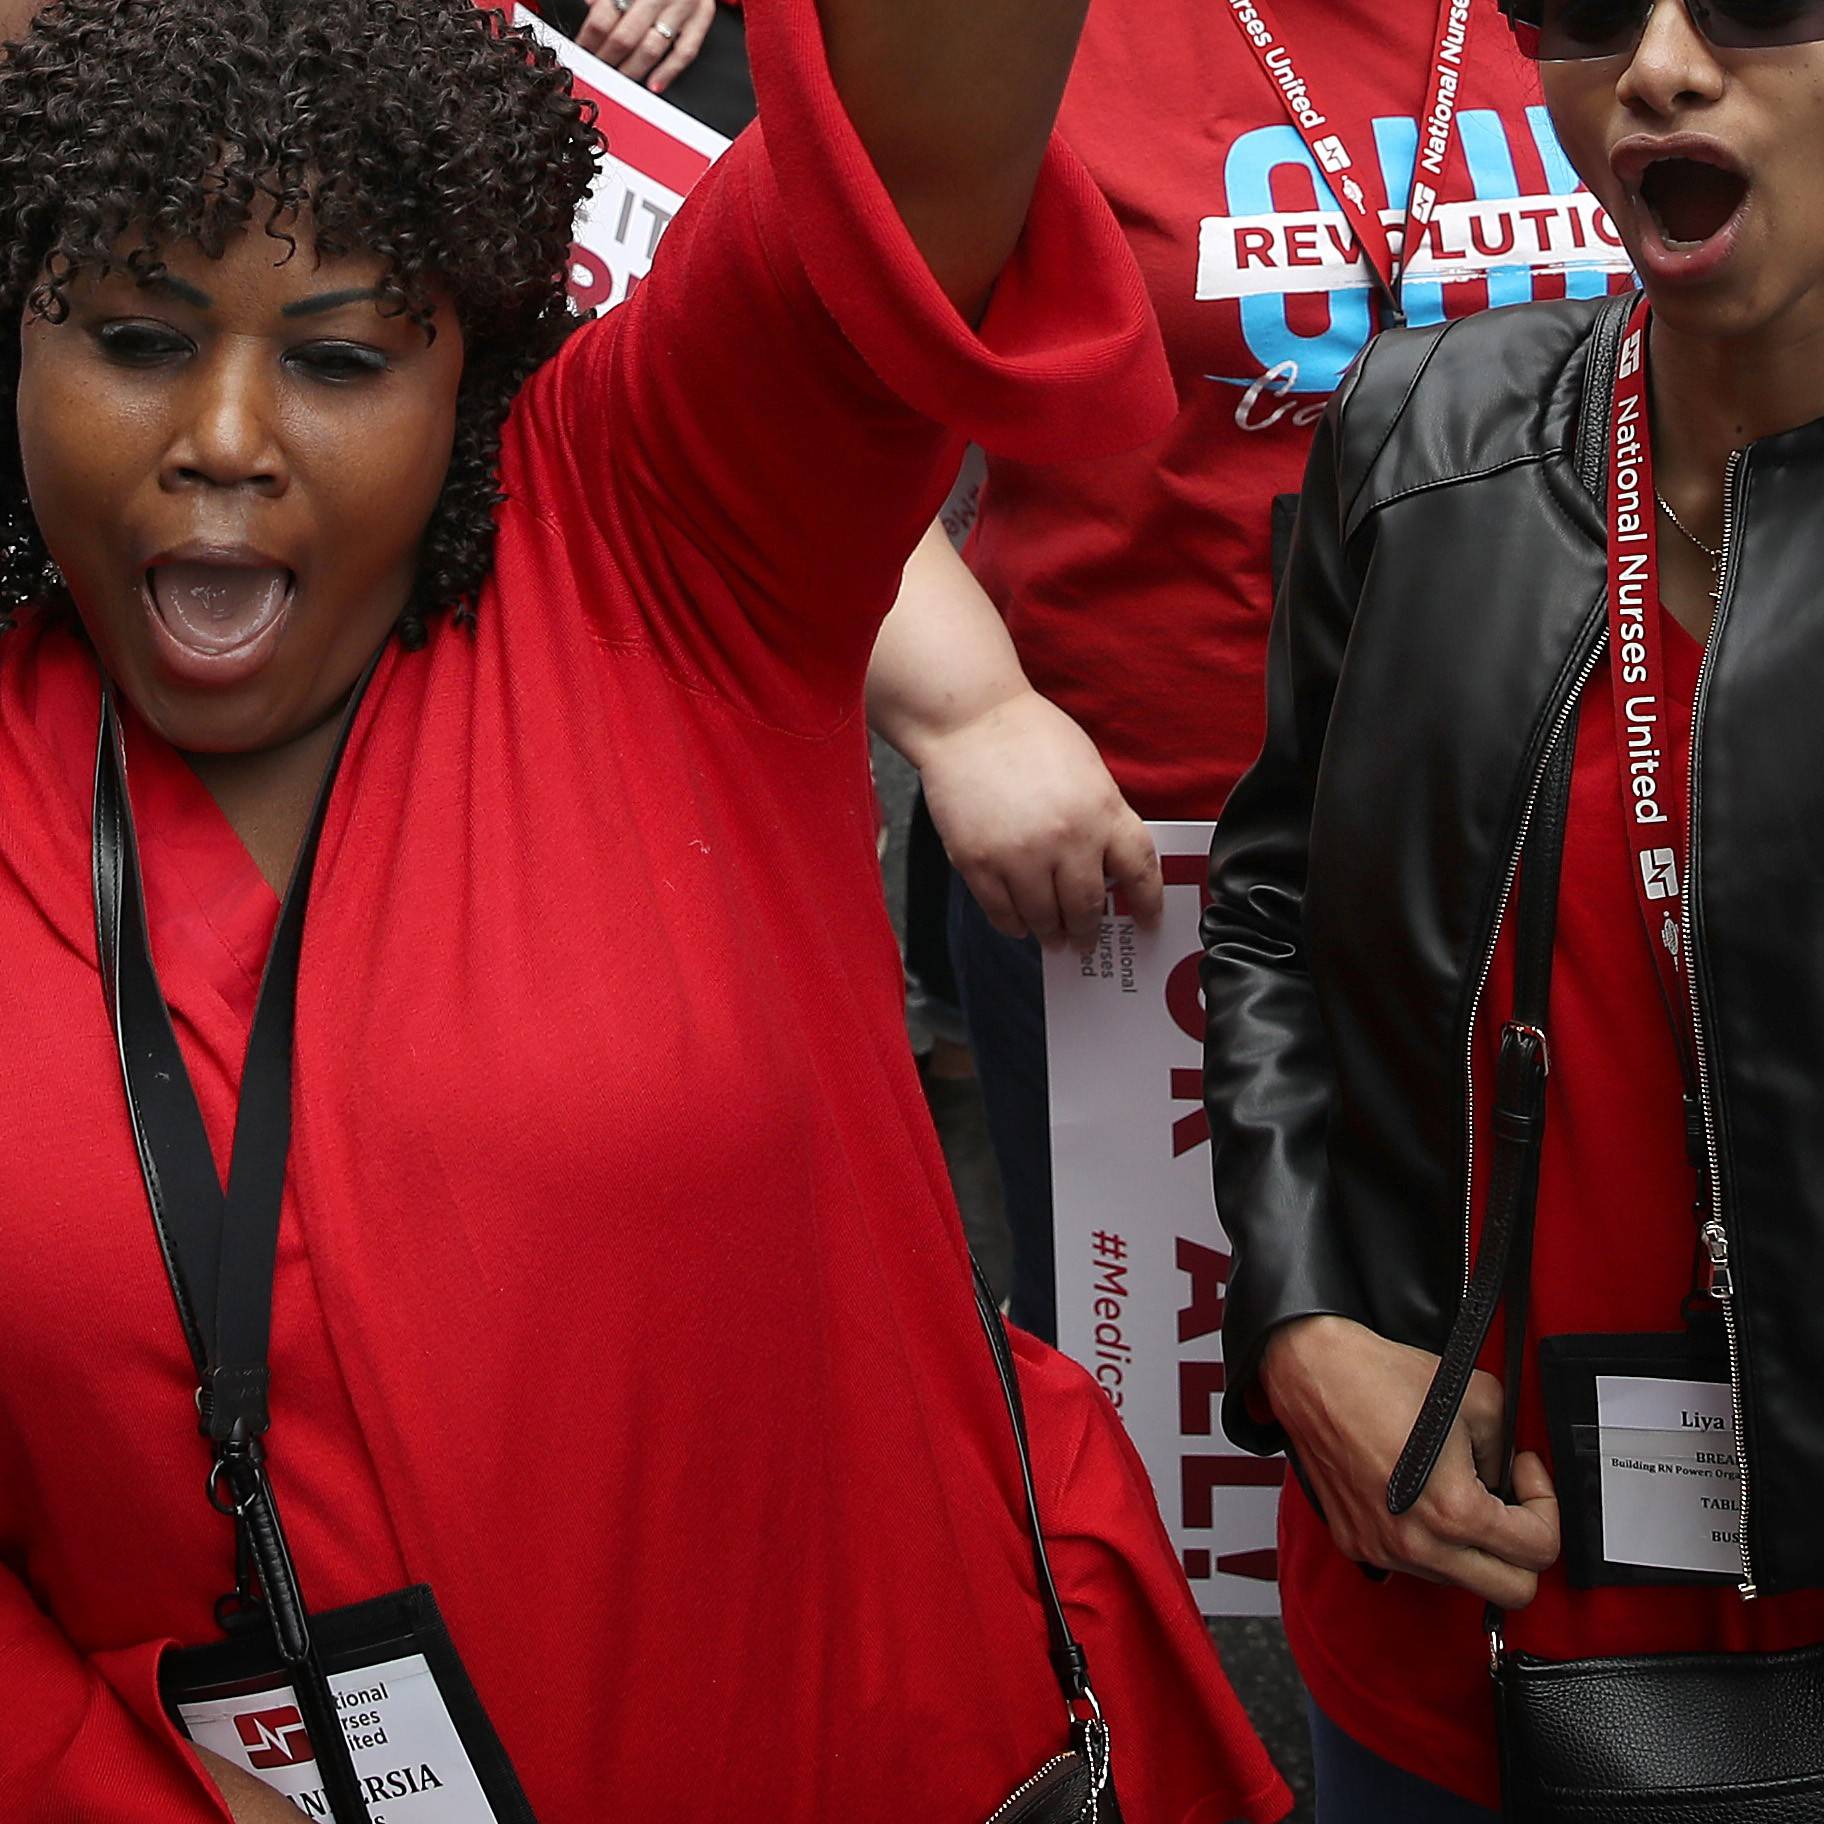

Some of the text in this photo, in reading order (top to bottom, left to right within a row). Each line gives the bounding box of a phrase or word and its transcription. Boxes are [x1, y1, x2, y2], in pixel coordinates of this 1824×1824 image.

[1264, 46, 1327, 130] United
[1421, 61, 1460, 176] National
[1614, 393, 1668, 825] National Nurses United
[1098, 922, 1114, 979] Nurses
[1118, 923, 1139, 994] National
[1680, 1409, 1725, 1433] Liya
[1611, 1457, 1657, 1473] Building
[1658, 1462, 1674, 1475] RN
[1675, 1464, 1713, 1478] Power:
